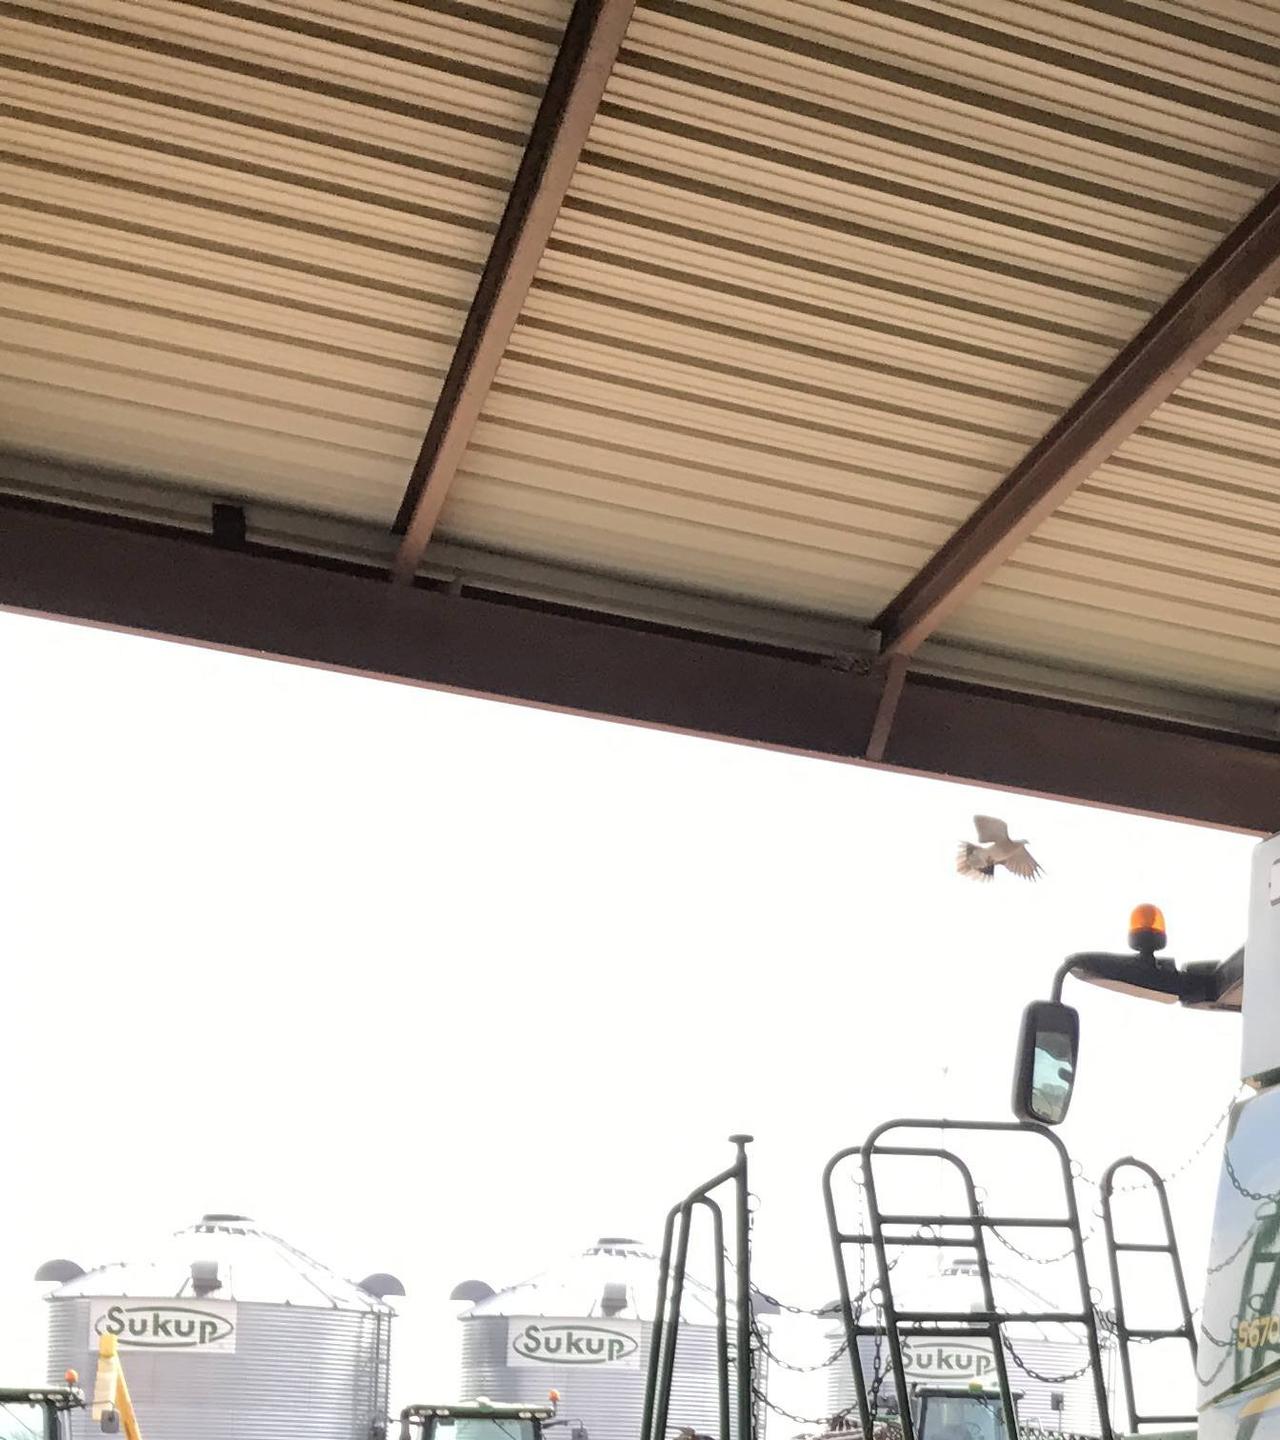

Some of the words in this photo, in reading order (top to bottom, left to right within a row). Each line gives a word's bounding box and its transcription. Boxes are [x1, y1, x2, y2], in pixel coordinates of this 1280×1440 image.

[106, 1306, 218, 1344] Sukup
[1237, 1316, 1280, 1351] S670
[523, 1325, 625, 1361] Sukup
[901, 1343, 991, 1376] Sukup
